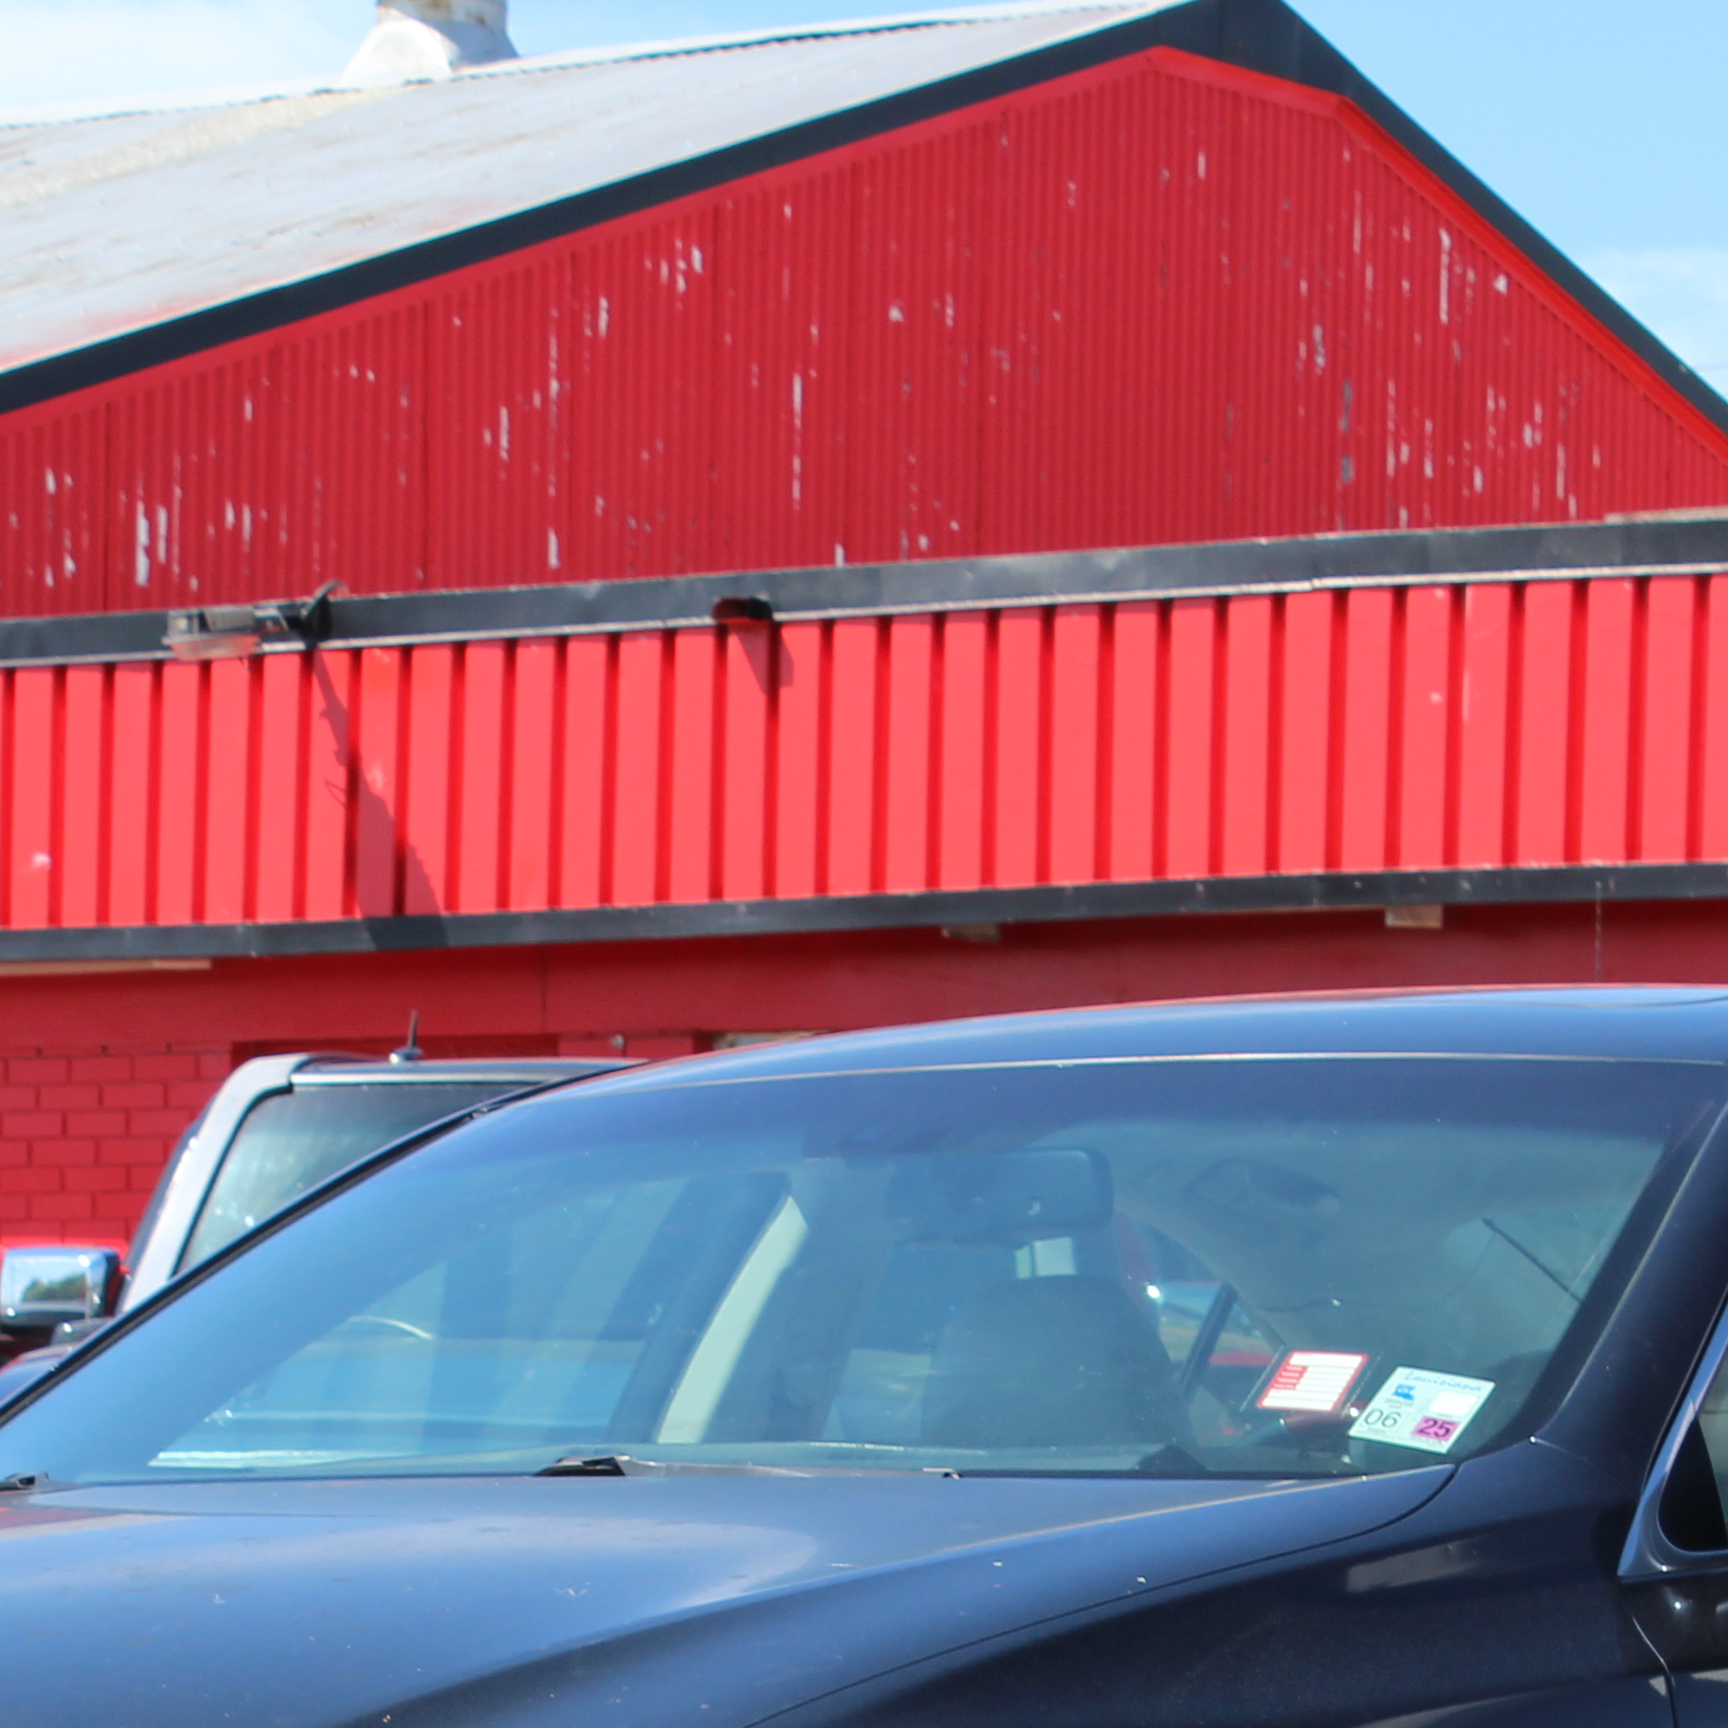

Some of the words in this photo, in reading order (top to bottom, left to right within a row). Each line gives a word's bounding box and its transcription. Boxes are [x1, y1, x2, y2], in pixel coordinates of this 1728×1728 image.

[1404, 1369, 1482, 1392] Louisiana
[1364, 1408, 1402, 1429] 06
[1417, 1416, 1453, 1438] 25
